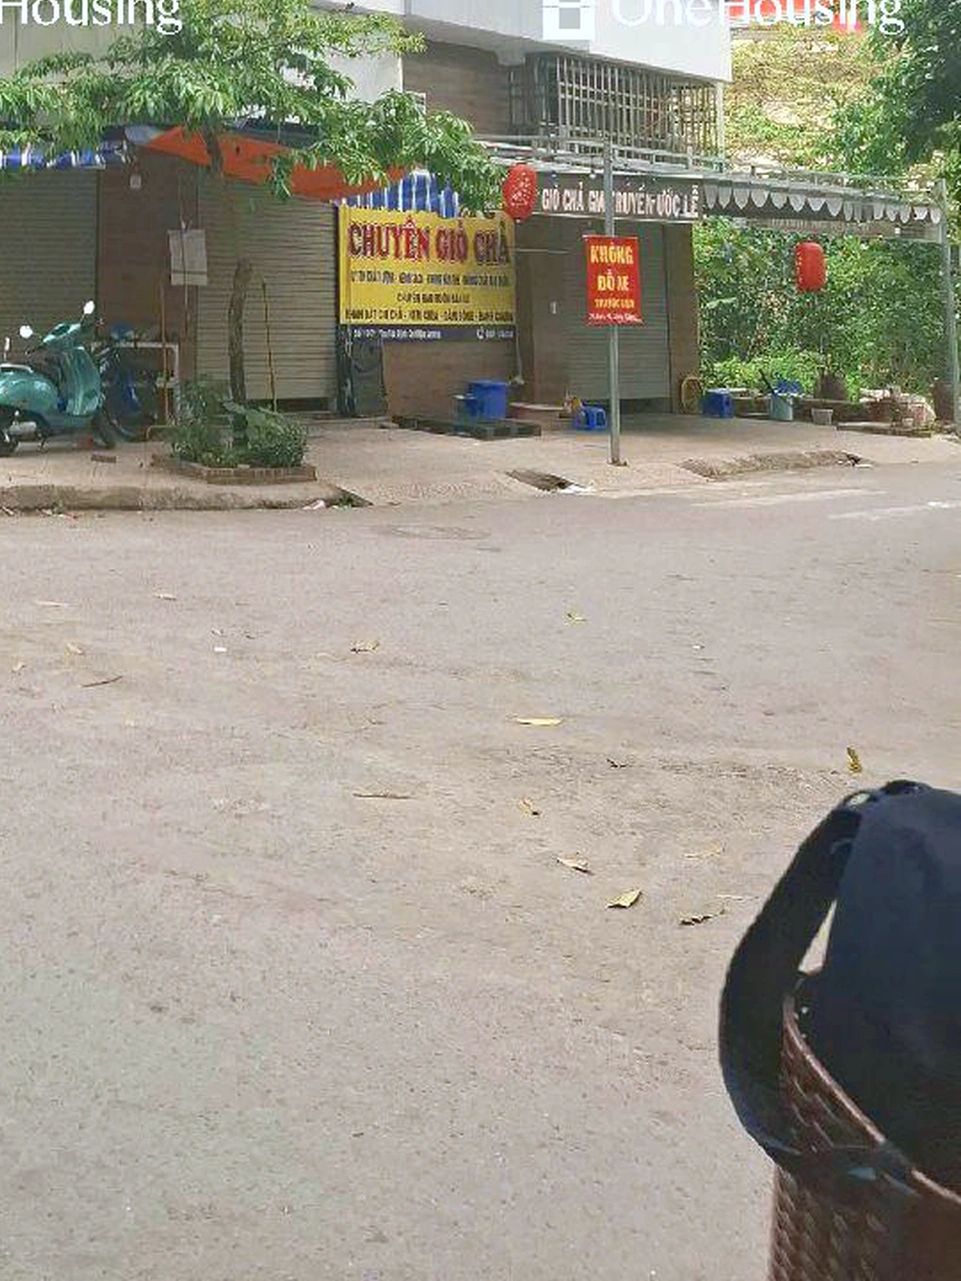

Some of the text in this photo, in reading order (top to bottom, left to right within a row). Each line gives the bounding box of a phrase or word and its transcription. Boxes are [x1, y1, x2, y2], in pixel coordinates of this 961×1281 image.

[562, 182, 584, 211] CHẢ
[348, 215, 430, 261] CHUYÊN
[435, 219, 468, 263] GIÒ
[590, 241, 634, 265] KHÔNG
